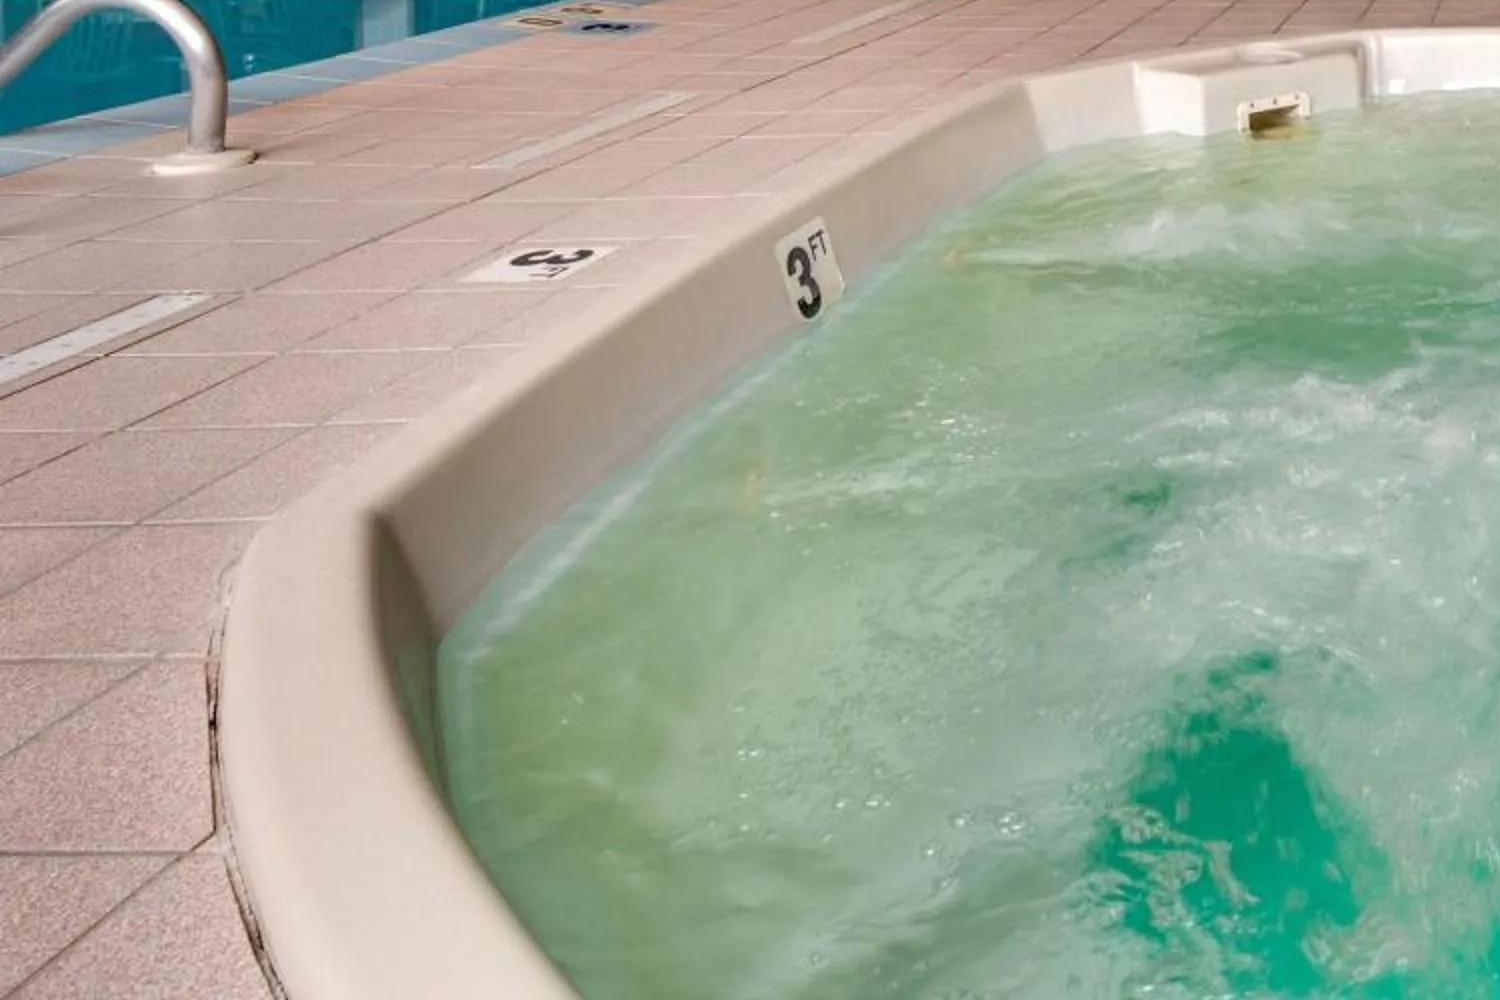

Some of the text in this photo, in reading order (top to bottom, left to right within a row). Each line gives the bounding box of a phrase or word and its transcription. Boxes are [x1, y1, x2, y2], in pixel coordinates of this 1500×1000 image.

[508, 249, 595, 267] 3
[787, 229, 827, 319] 3 FT
